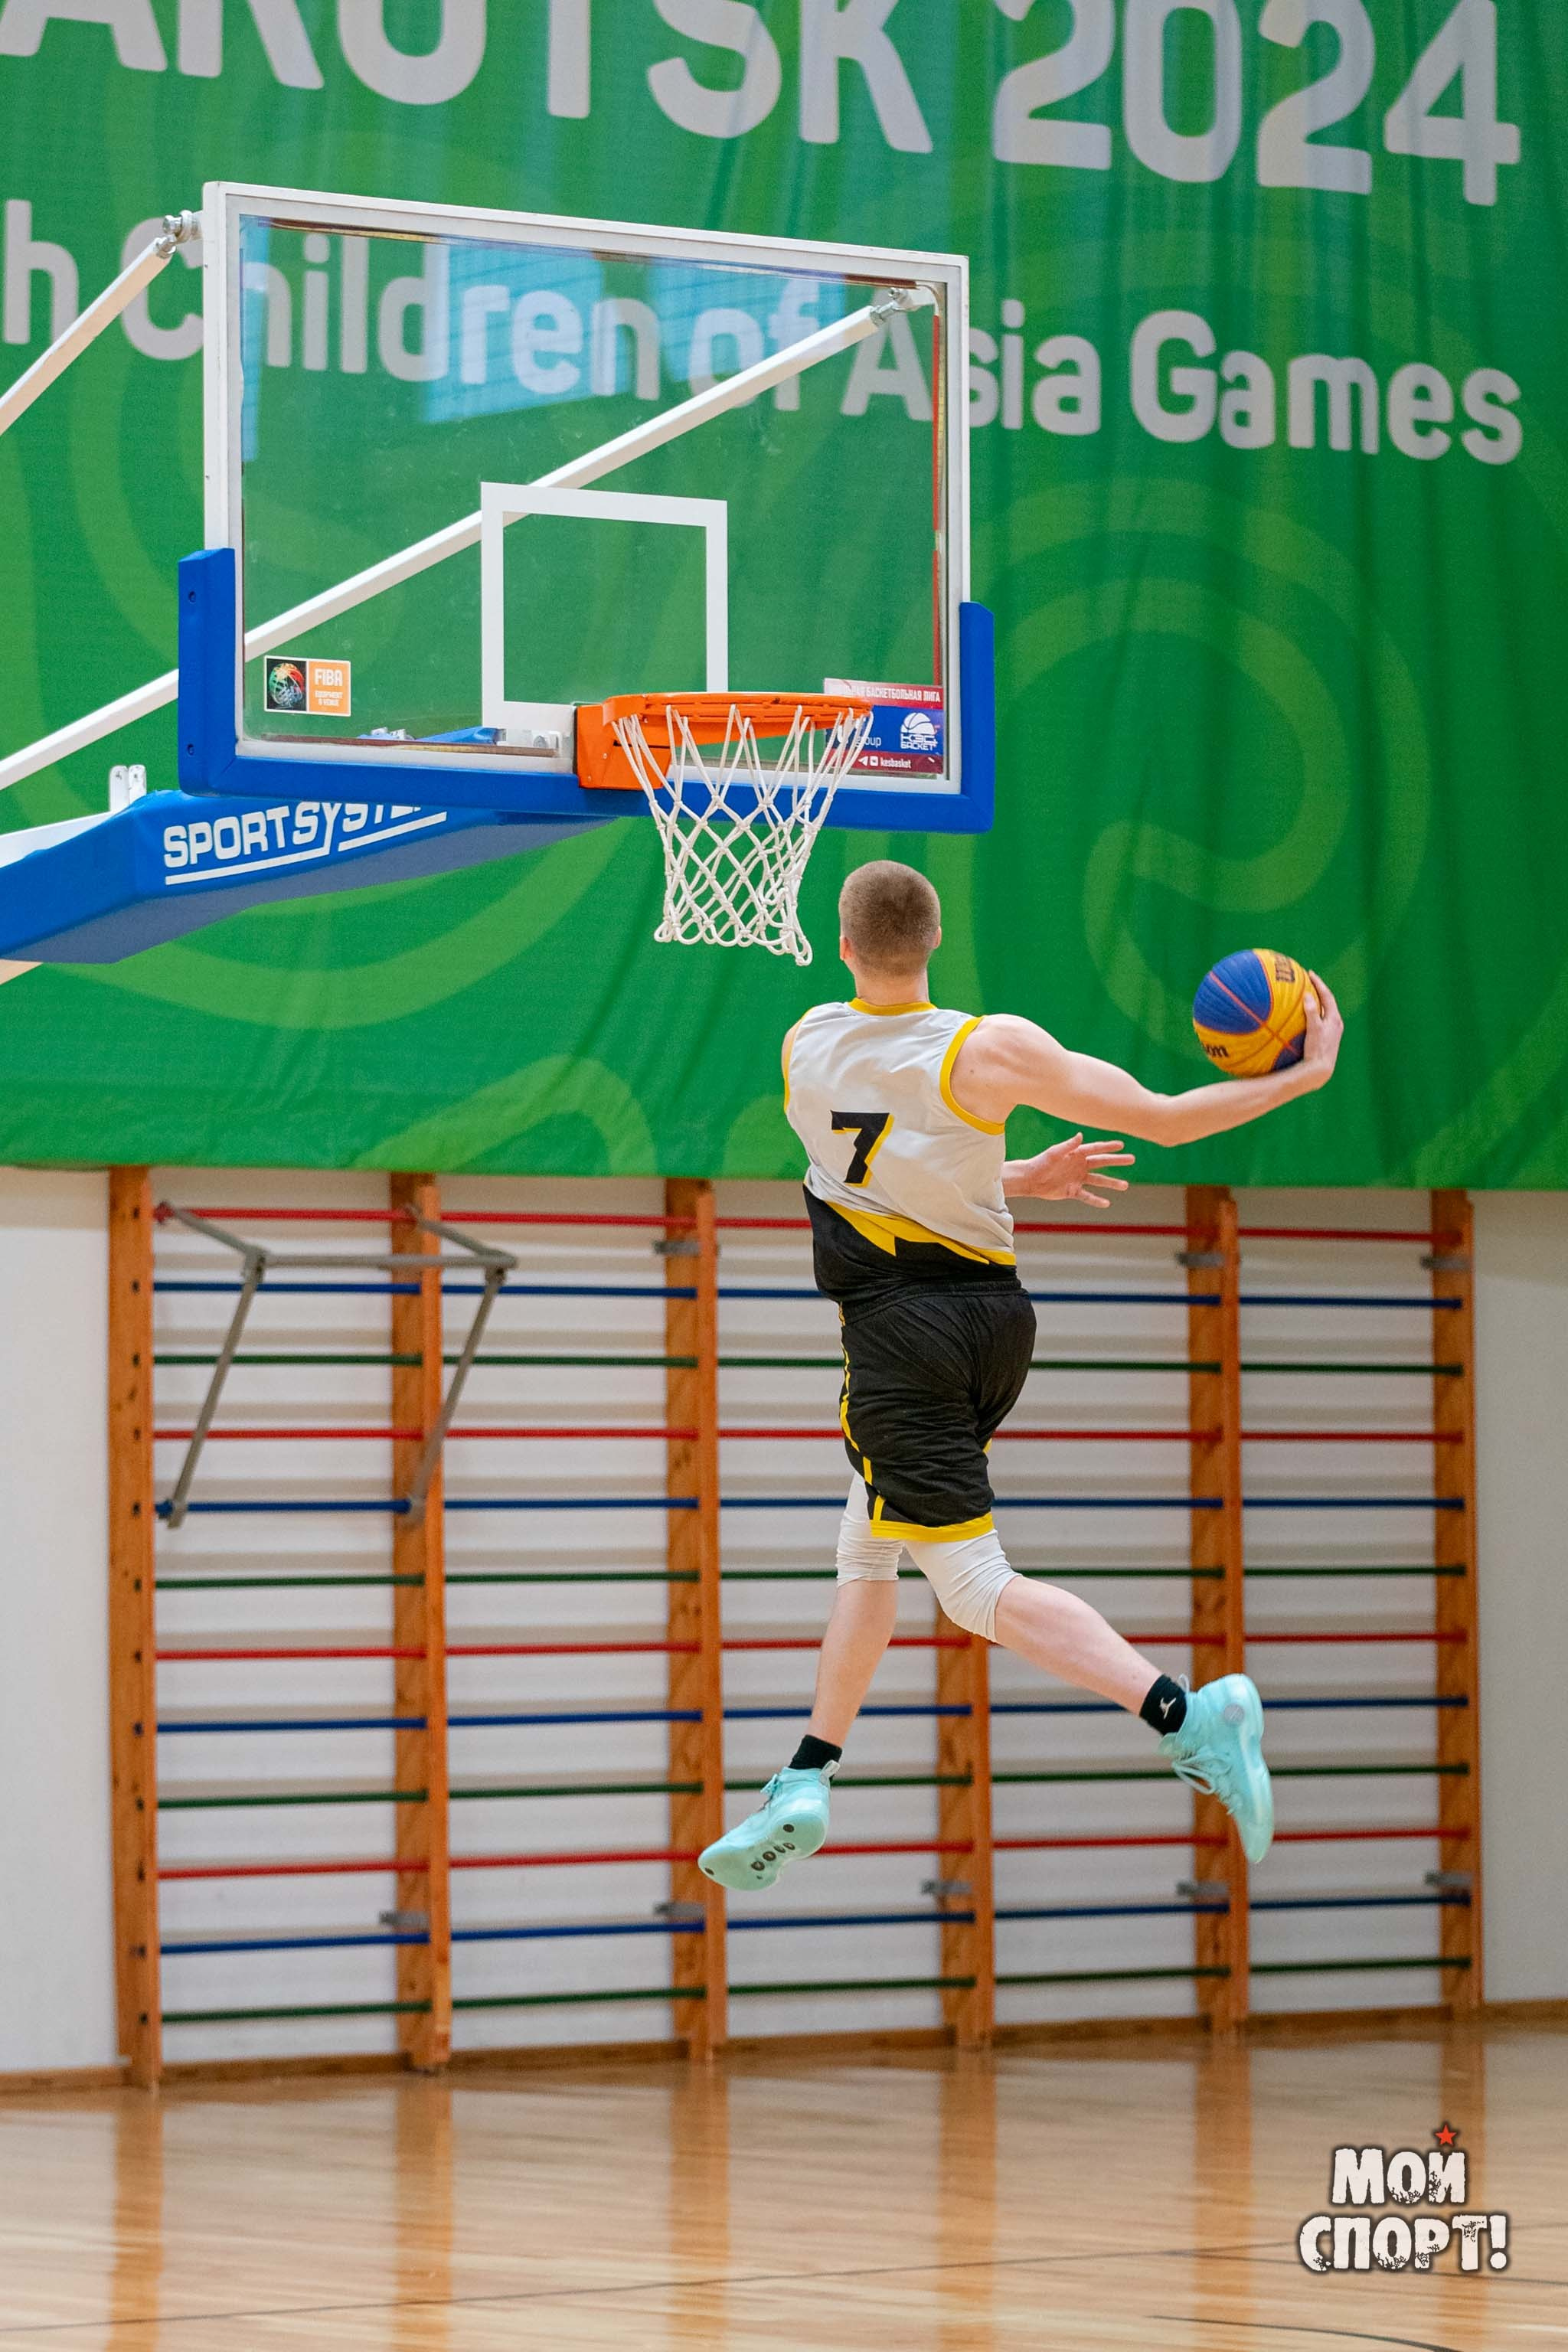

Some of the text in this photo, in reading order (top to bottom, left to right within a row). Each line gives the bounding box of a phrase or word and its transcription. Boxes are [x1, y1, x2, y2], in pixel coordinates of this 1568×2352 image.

[992, 0, 1521, 206] 2024
[689, 279, 820, 411] of
[839, 284, 1102, 436] Asia
[1129, 309, 1523, 465] Games
[314, 668, 343, 687] FIBA
[923, 691, 941, 703] ЛИГА
[830, 1110, 894, 1187] 7
